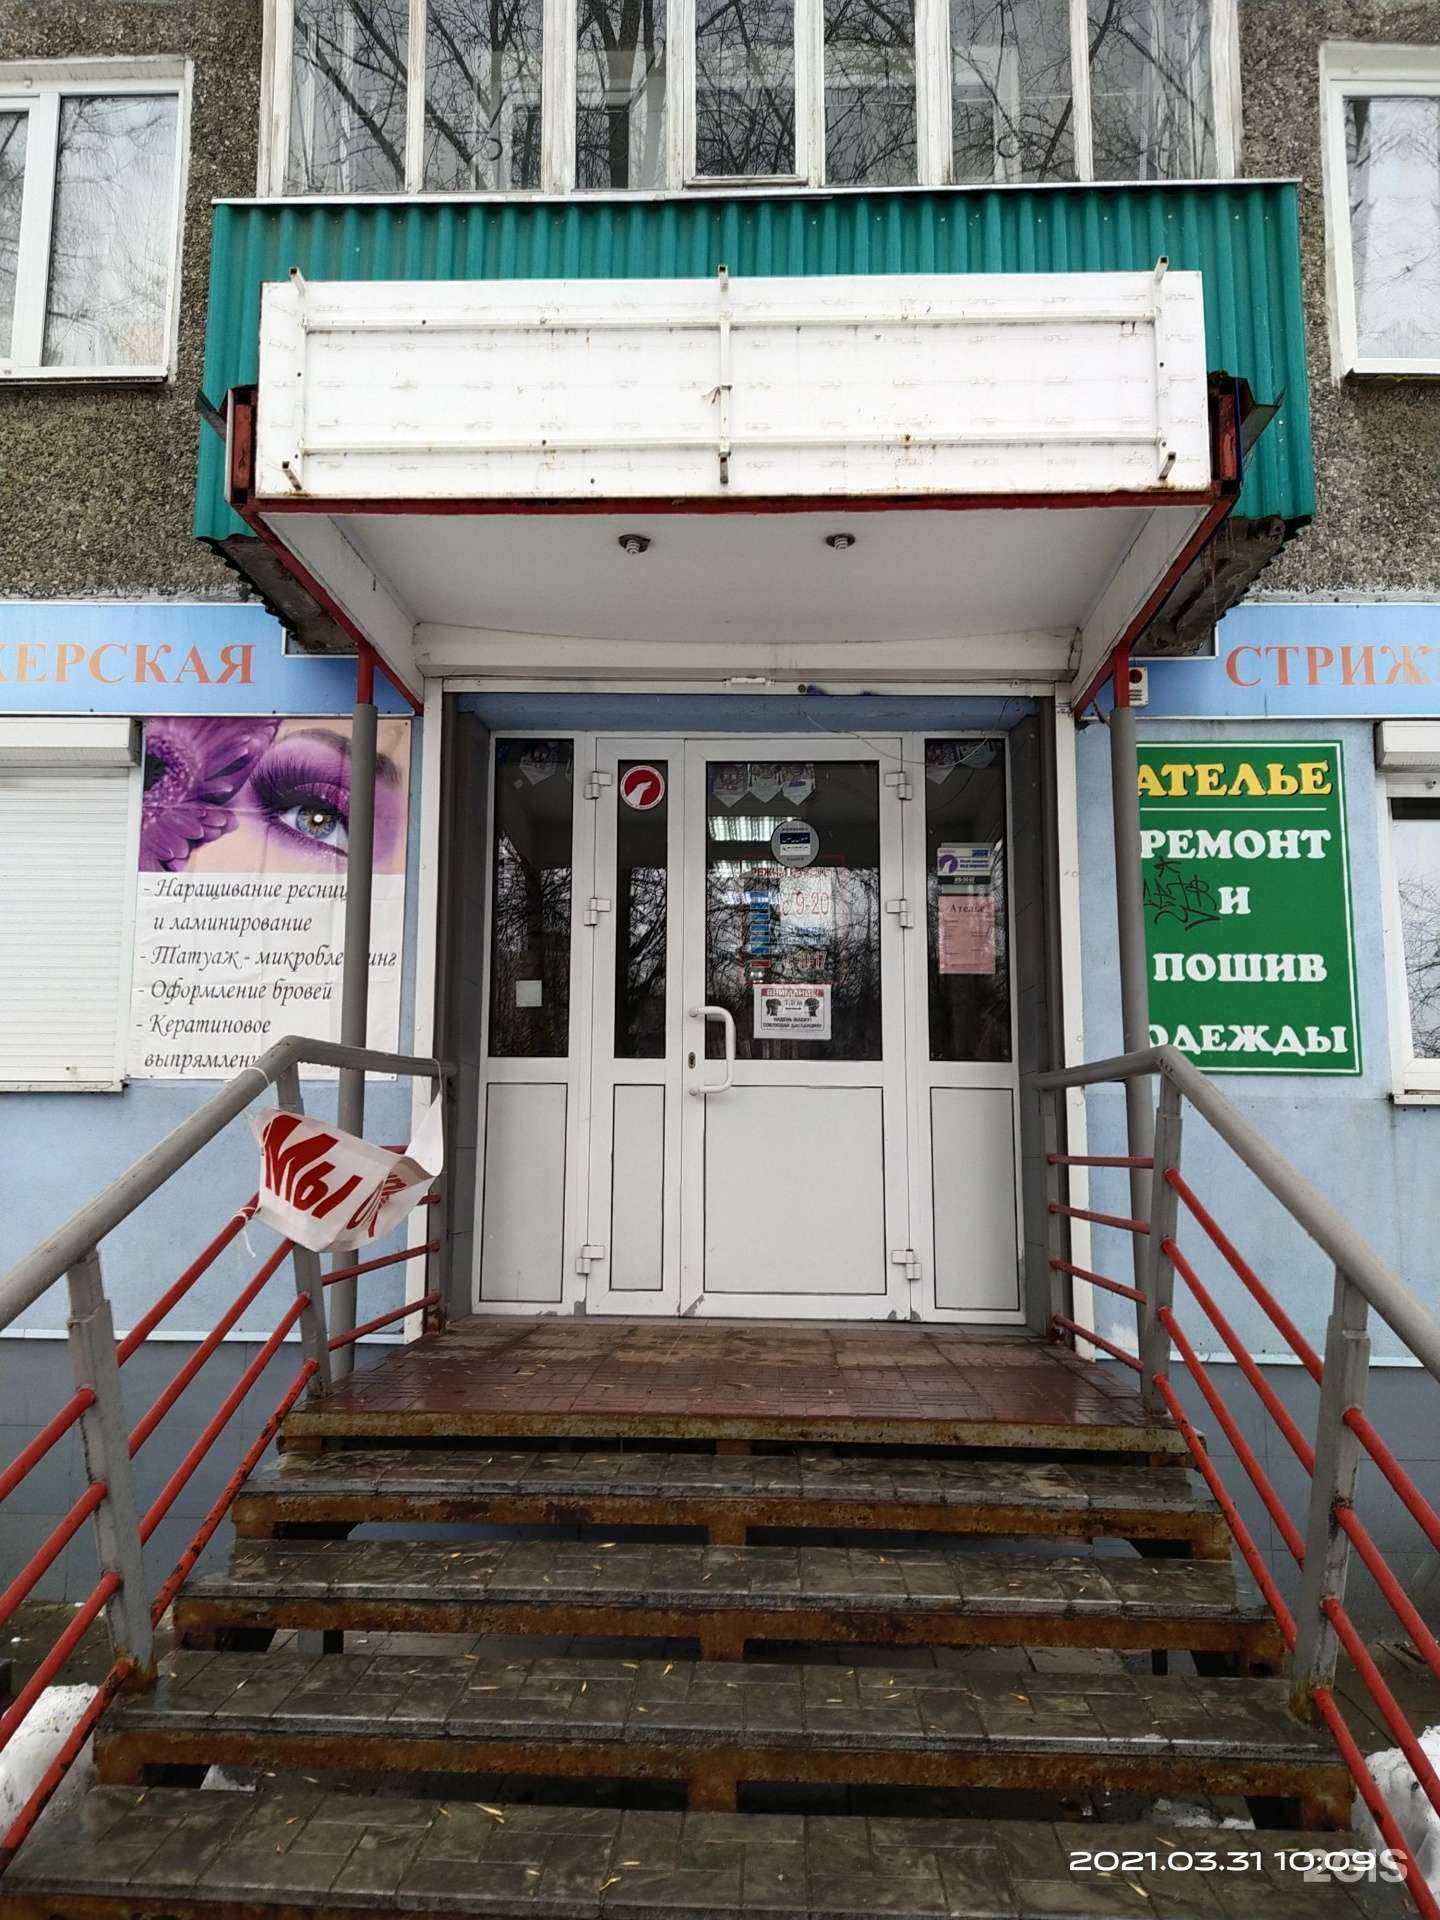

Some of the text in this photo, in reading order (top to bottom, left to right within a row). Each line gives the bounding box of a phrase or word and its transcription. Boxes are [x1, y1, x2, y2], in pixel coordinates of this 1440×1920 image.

[0, 642, 256, 685] ЕРСКАЯ
[1137, 763, 1332, 797] АТЕЛЬЕ
[1140, 829, 1332, 859] РЕМОНТ
[154, 877, 282, 903] Наращивание
[1218, 886, 1251, 915] И
[154, 917, 312, 937] и ламинирование
[150, 944, 242, 971] Татуаж
[1153, 953, 1328, 982] ПОШИВ
[151, 977, 267, 1005] Оформление
[272, 978, 333, 1006] бровей
[150, 1014, 272, 1039] Кератиновое
